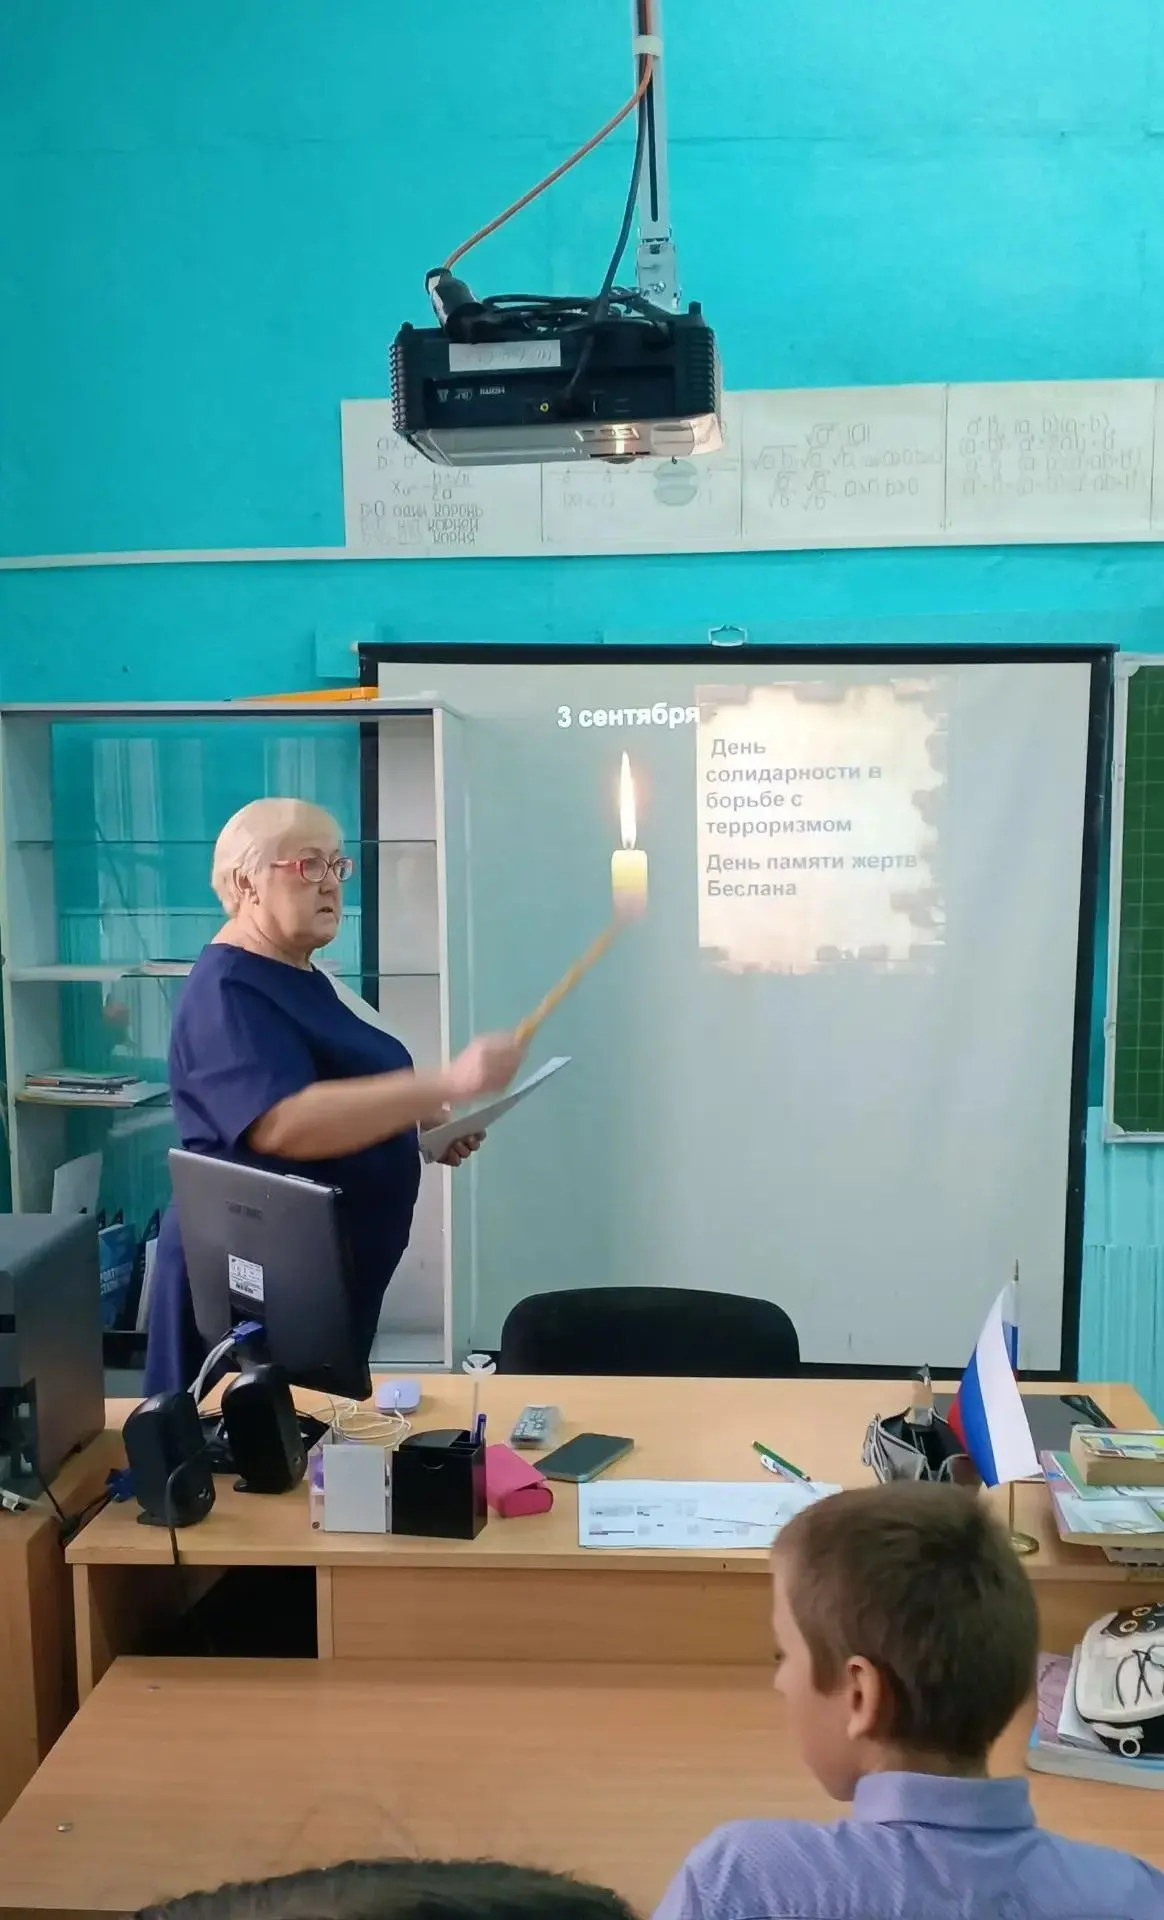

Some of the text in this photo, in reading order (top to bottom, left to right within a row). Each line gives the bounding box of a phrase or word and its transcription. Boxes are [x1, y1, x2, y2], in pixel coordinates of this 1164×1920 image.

[557, 702, 701, 729] 3 сентября
[711, 738, 766, 758] День
[706, 765, 883, 783] солидарности в
[706, 792, 803, 812] борьбе с
[706, 818, 852, 837] терроризмом
[706, 854, 917, 874] День памяти жертв
[707, 880, 796, 897] Беслана
